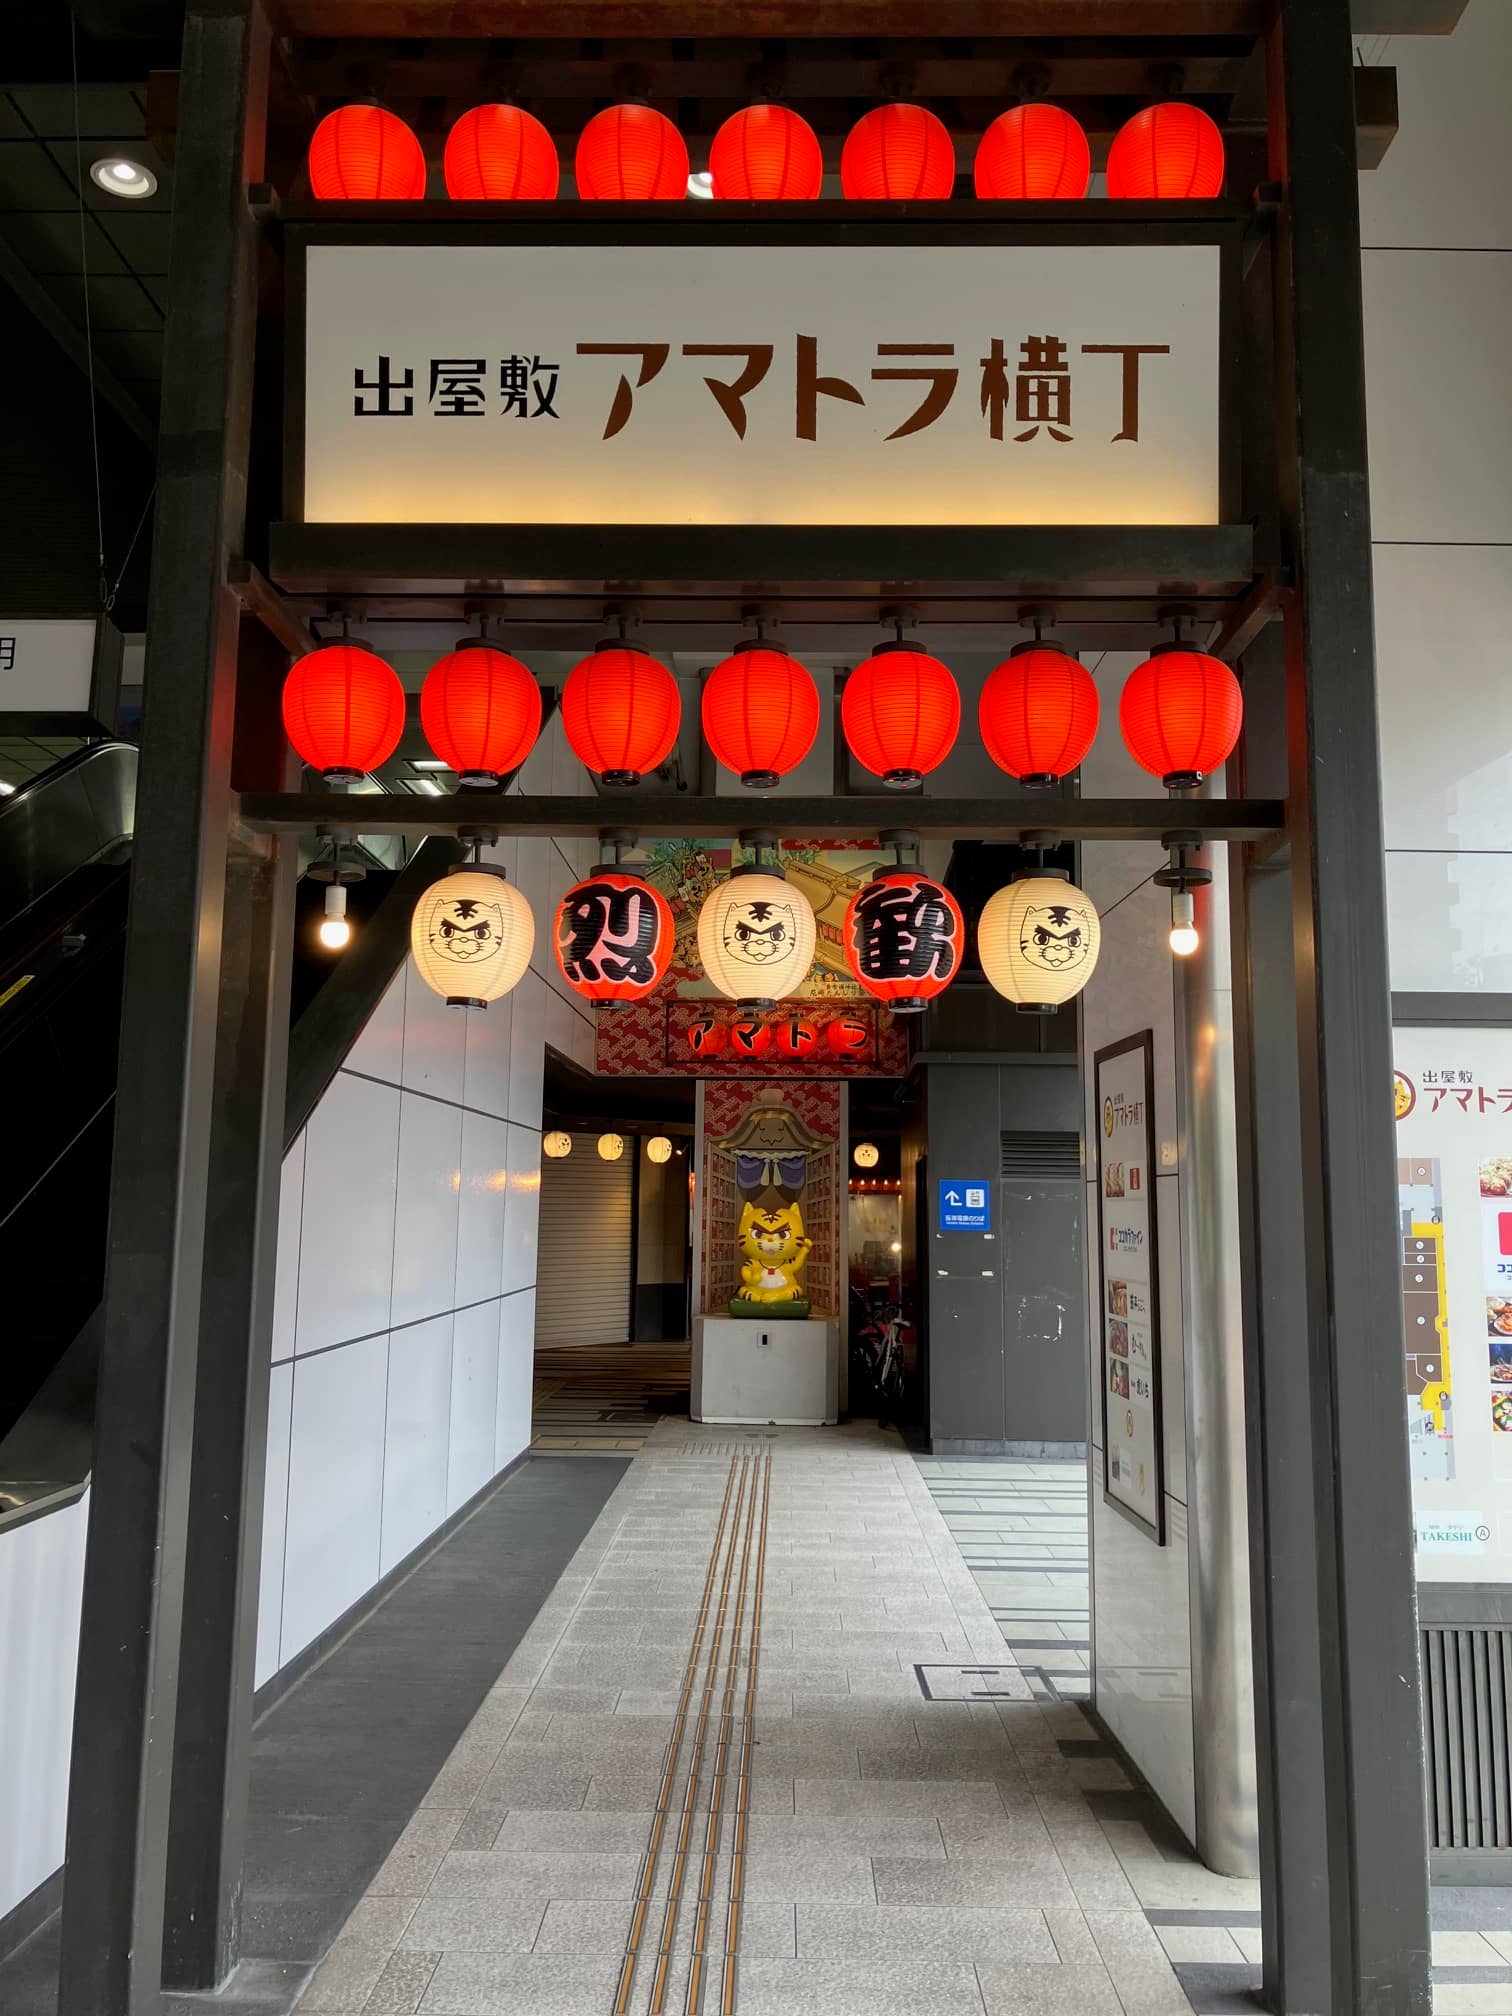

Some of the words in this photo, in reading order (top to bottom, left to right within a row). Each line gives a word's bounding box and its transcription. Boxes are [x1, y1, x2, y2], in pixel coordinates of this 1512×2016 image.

[1423, 1070, 1472, 1084] 出屋敷
[1420, 1532, 1472, 1542] TAKESHI
